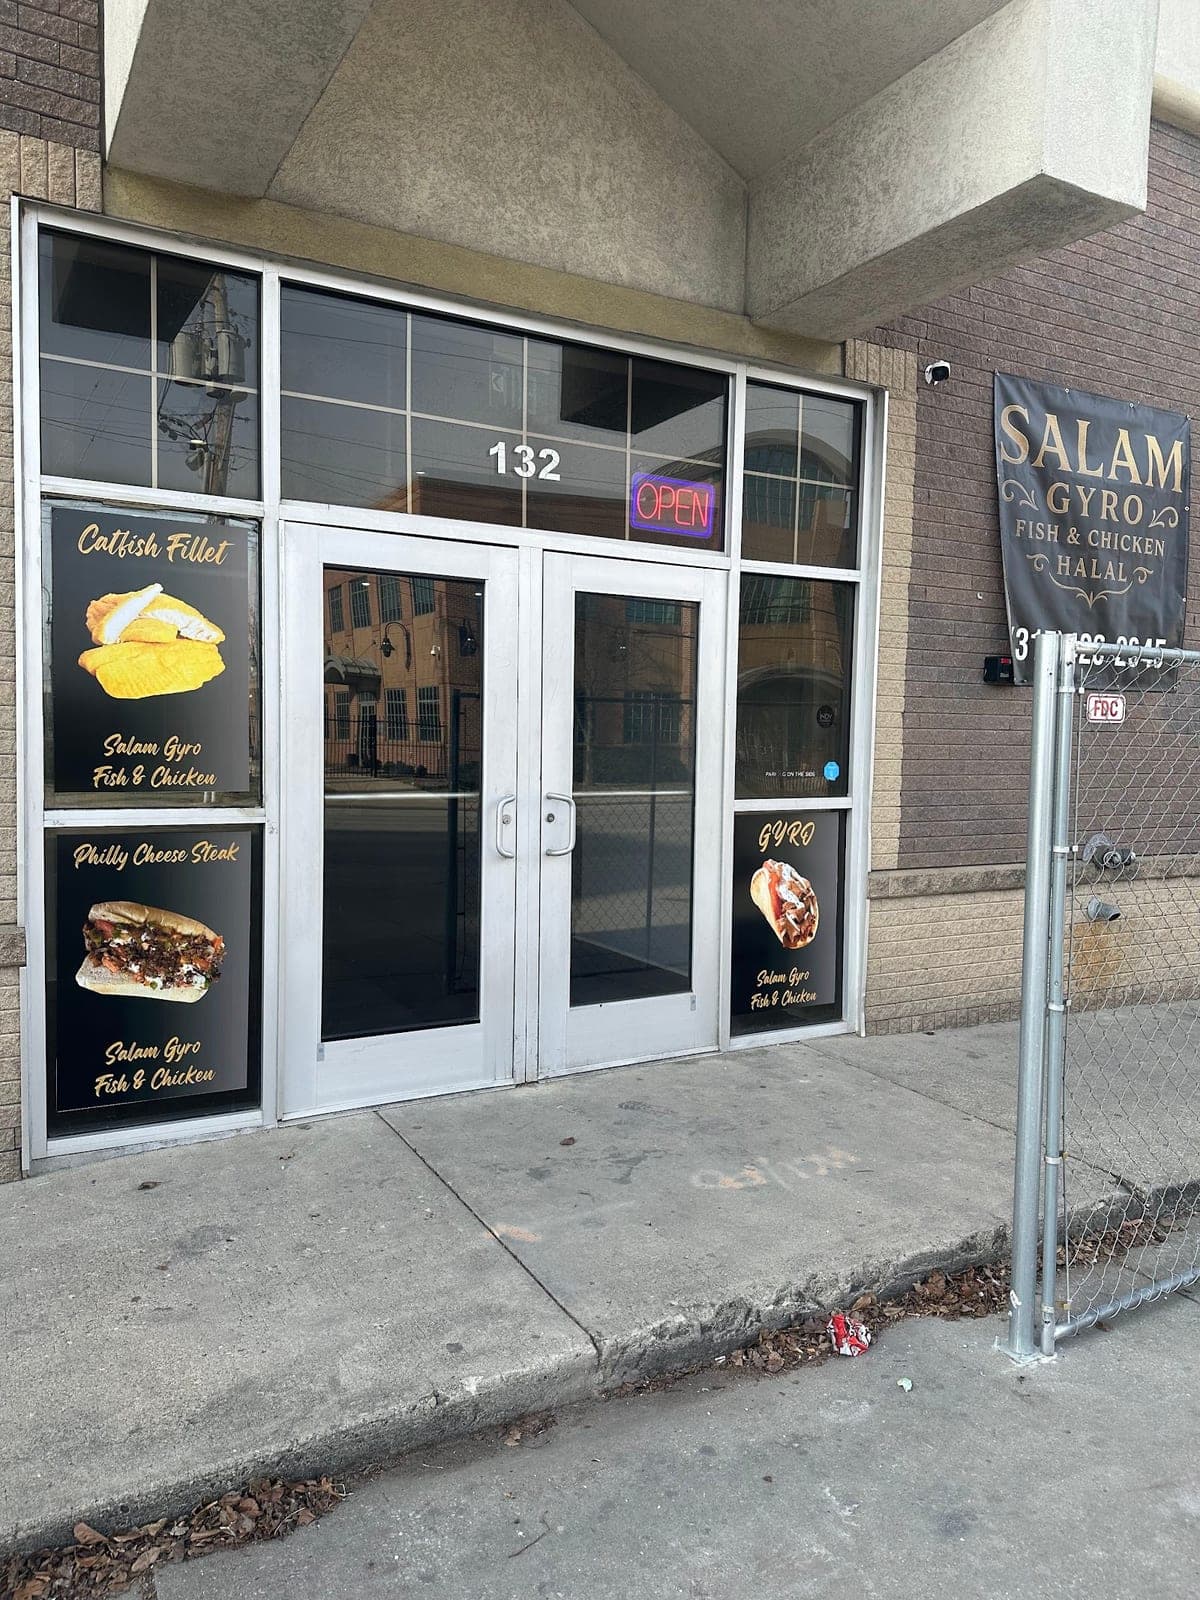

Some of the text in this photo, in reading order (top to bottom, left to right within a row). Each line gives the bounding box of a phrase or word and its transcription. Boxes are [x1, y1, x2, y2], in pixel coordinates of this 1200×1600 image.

[489, 441, 561, 481] 132
[1000, 404, 1184, 493] SALAM
[636, 482, 709, 528] OPEN
[1046, 481, 1143, 525] GYRO
[77, 523, 235, 565] Catfish Fillet
[1015, 519, 1165, 557] FISH & CHICKEN
[1057, 555, 1127, 583] HALAL
[1093, 700, 1118, 717] FDC
[103, 734, 202, 763] Salam Gyro
[93, 765, 217, 789] Fish & Chicken
[758, 820, 815, 853] GYRO
[73, 840, 240, 871] Philly Cheese Steak
[756, 967, 810, 987] Salam Gyro
[751, 990, 817, 1010] Fish & Chicken
[105, 1036, 200, 1065] Salam Gyro
[94, 1065, 216, 1097] Fish & Chicken
